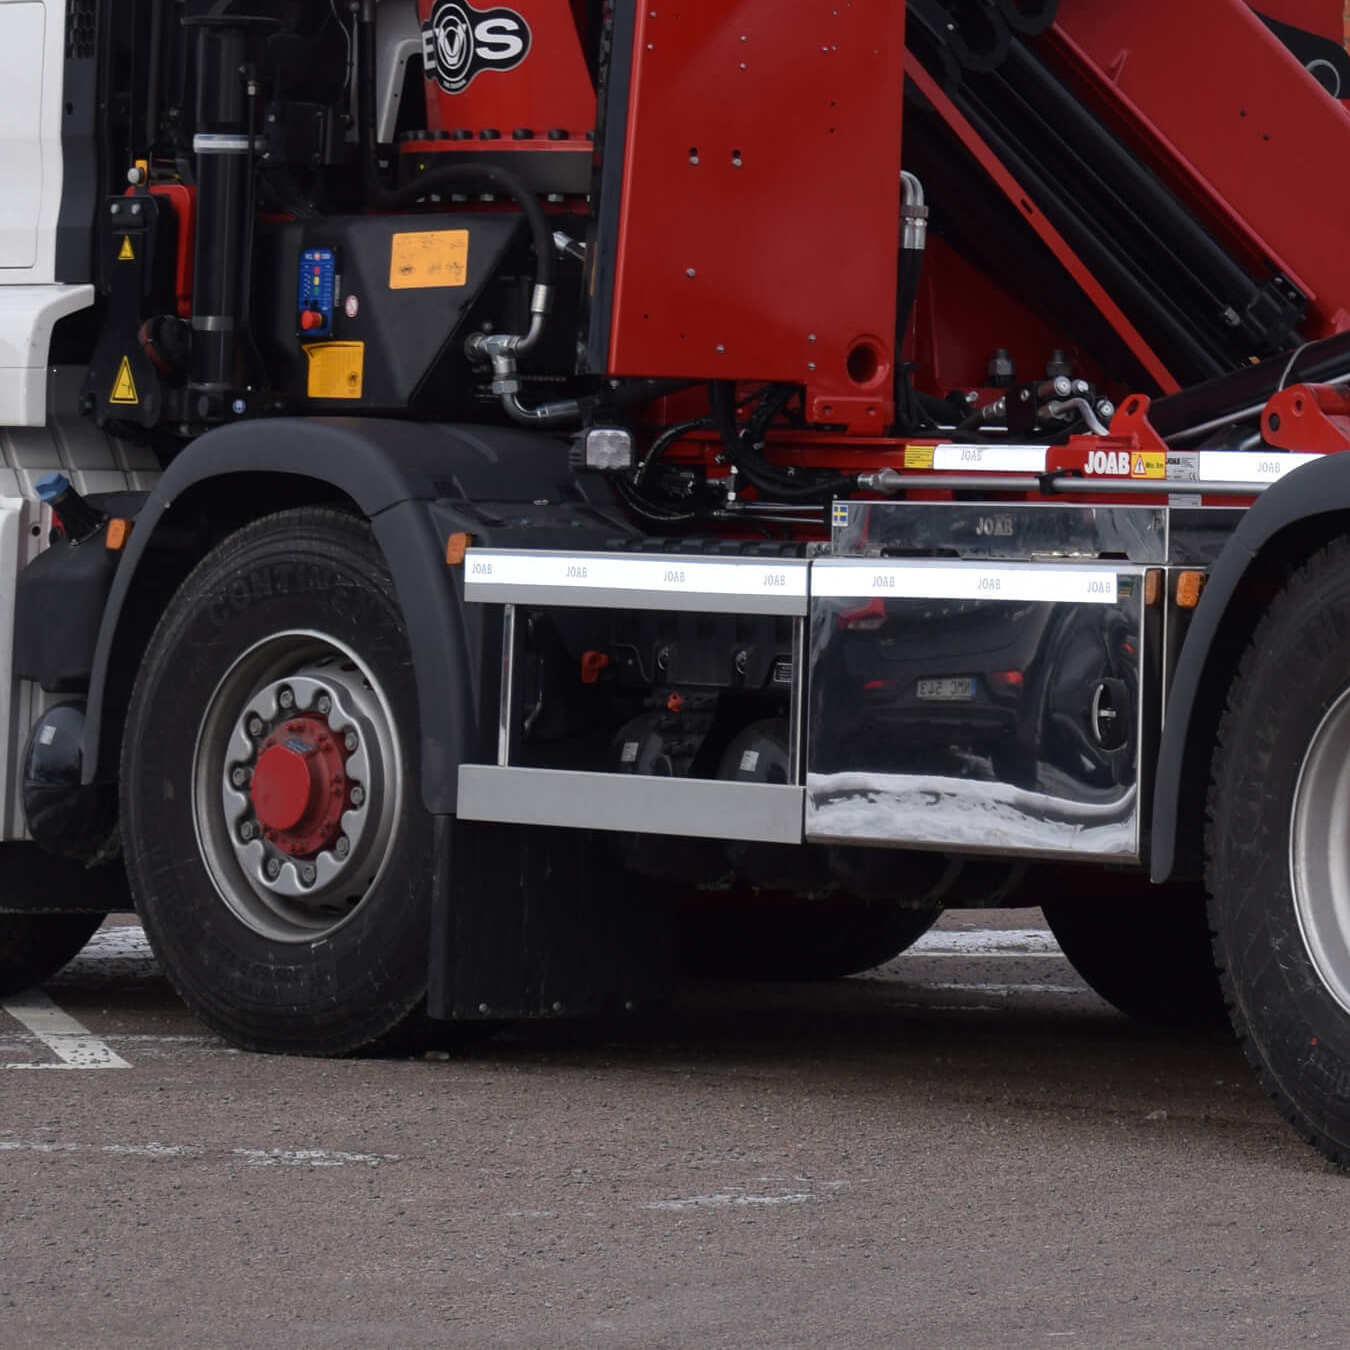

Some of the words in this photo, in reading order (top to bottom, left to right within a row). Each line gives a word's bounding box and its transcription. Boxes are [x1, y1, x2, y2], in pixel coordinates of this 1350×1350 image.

[959, 449, 983, 461] JOAB
[1084, 451, 1130, 475] JOAB
[1256, 460, 1281, 473] JOAB
[471, 563, 493, 575] JOAB
[565, 566, 588, 578] JOAB
[663, 569, 686, 582] JOAB
[763, 573, 786, 586] JOAB
[871, 576, 895, 588] JOAB
[976, 577, 1001, 590] JOAB
[1086, 581, 1111, 593] JOAB
